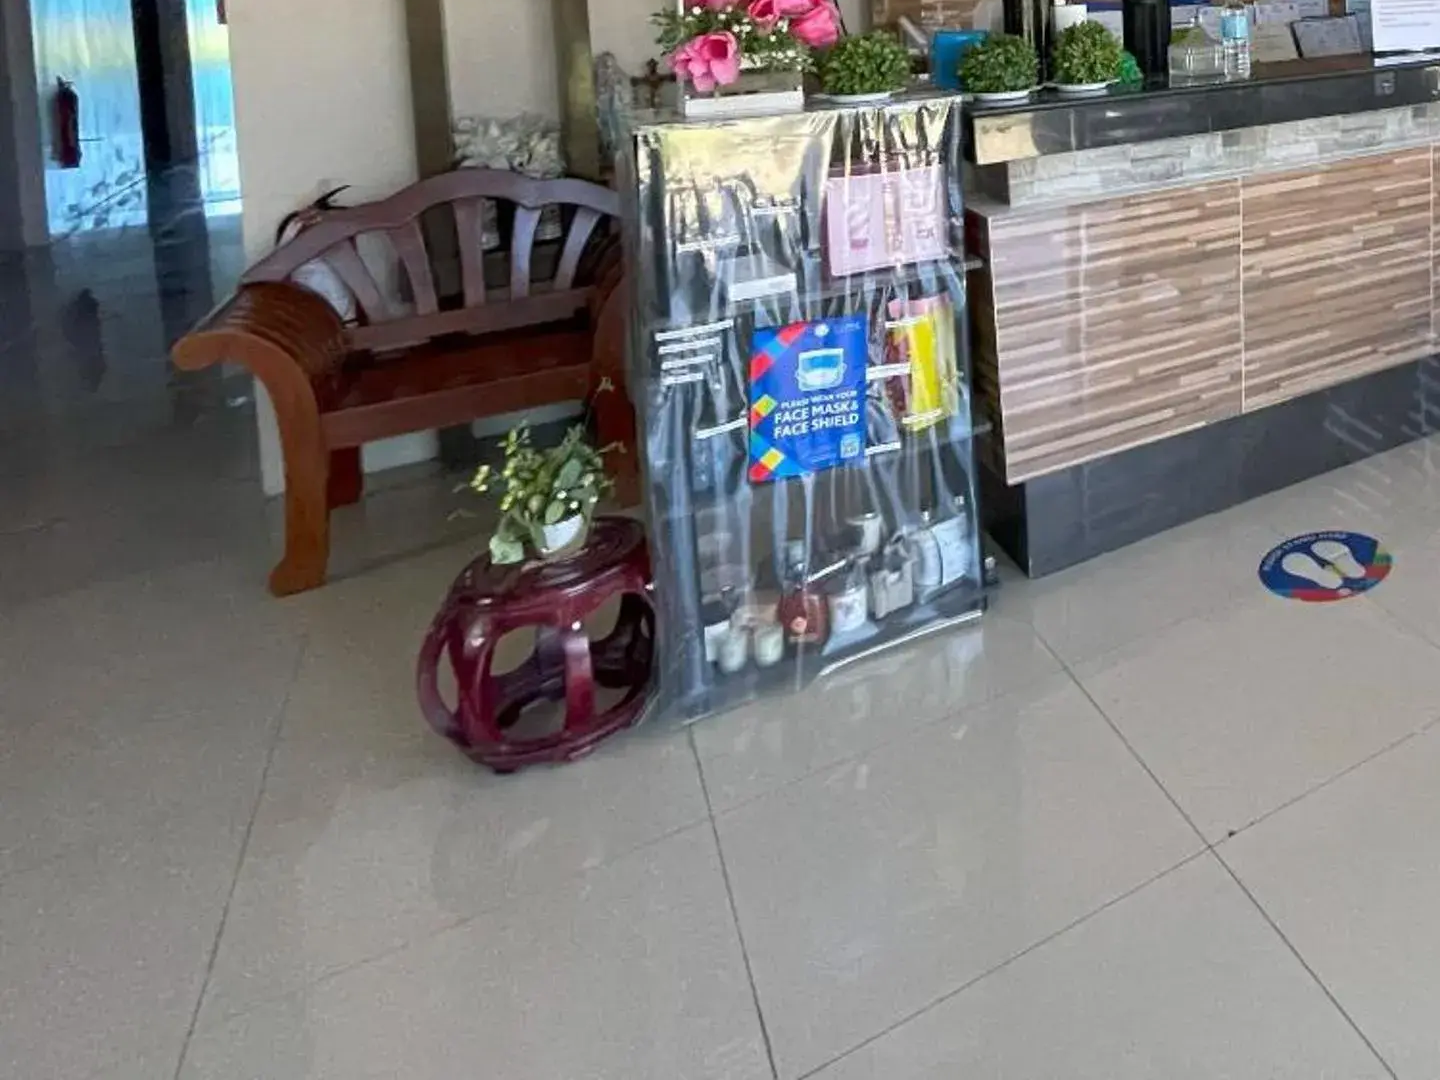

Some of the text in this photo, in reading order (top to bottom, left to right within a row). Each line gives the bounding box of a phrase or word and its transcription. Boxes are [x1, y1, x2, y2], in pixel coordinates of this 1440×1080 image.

[775, 408, 809, 424] FACE
[811, 402, 850, 416] MASK
[774, 413, 859, 440] FACE SHIELD
